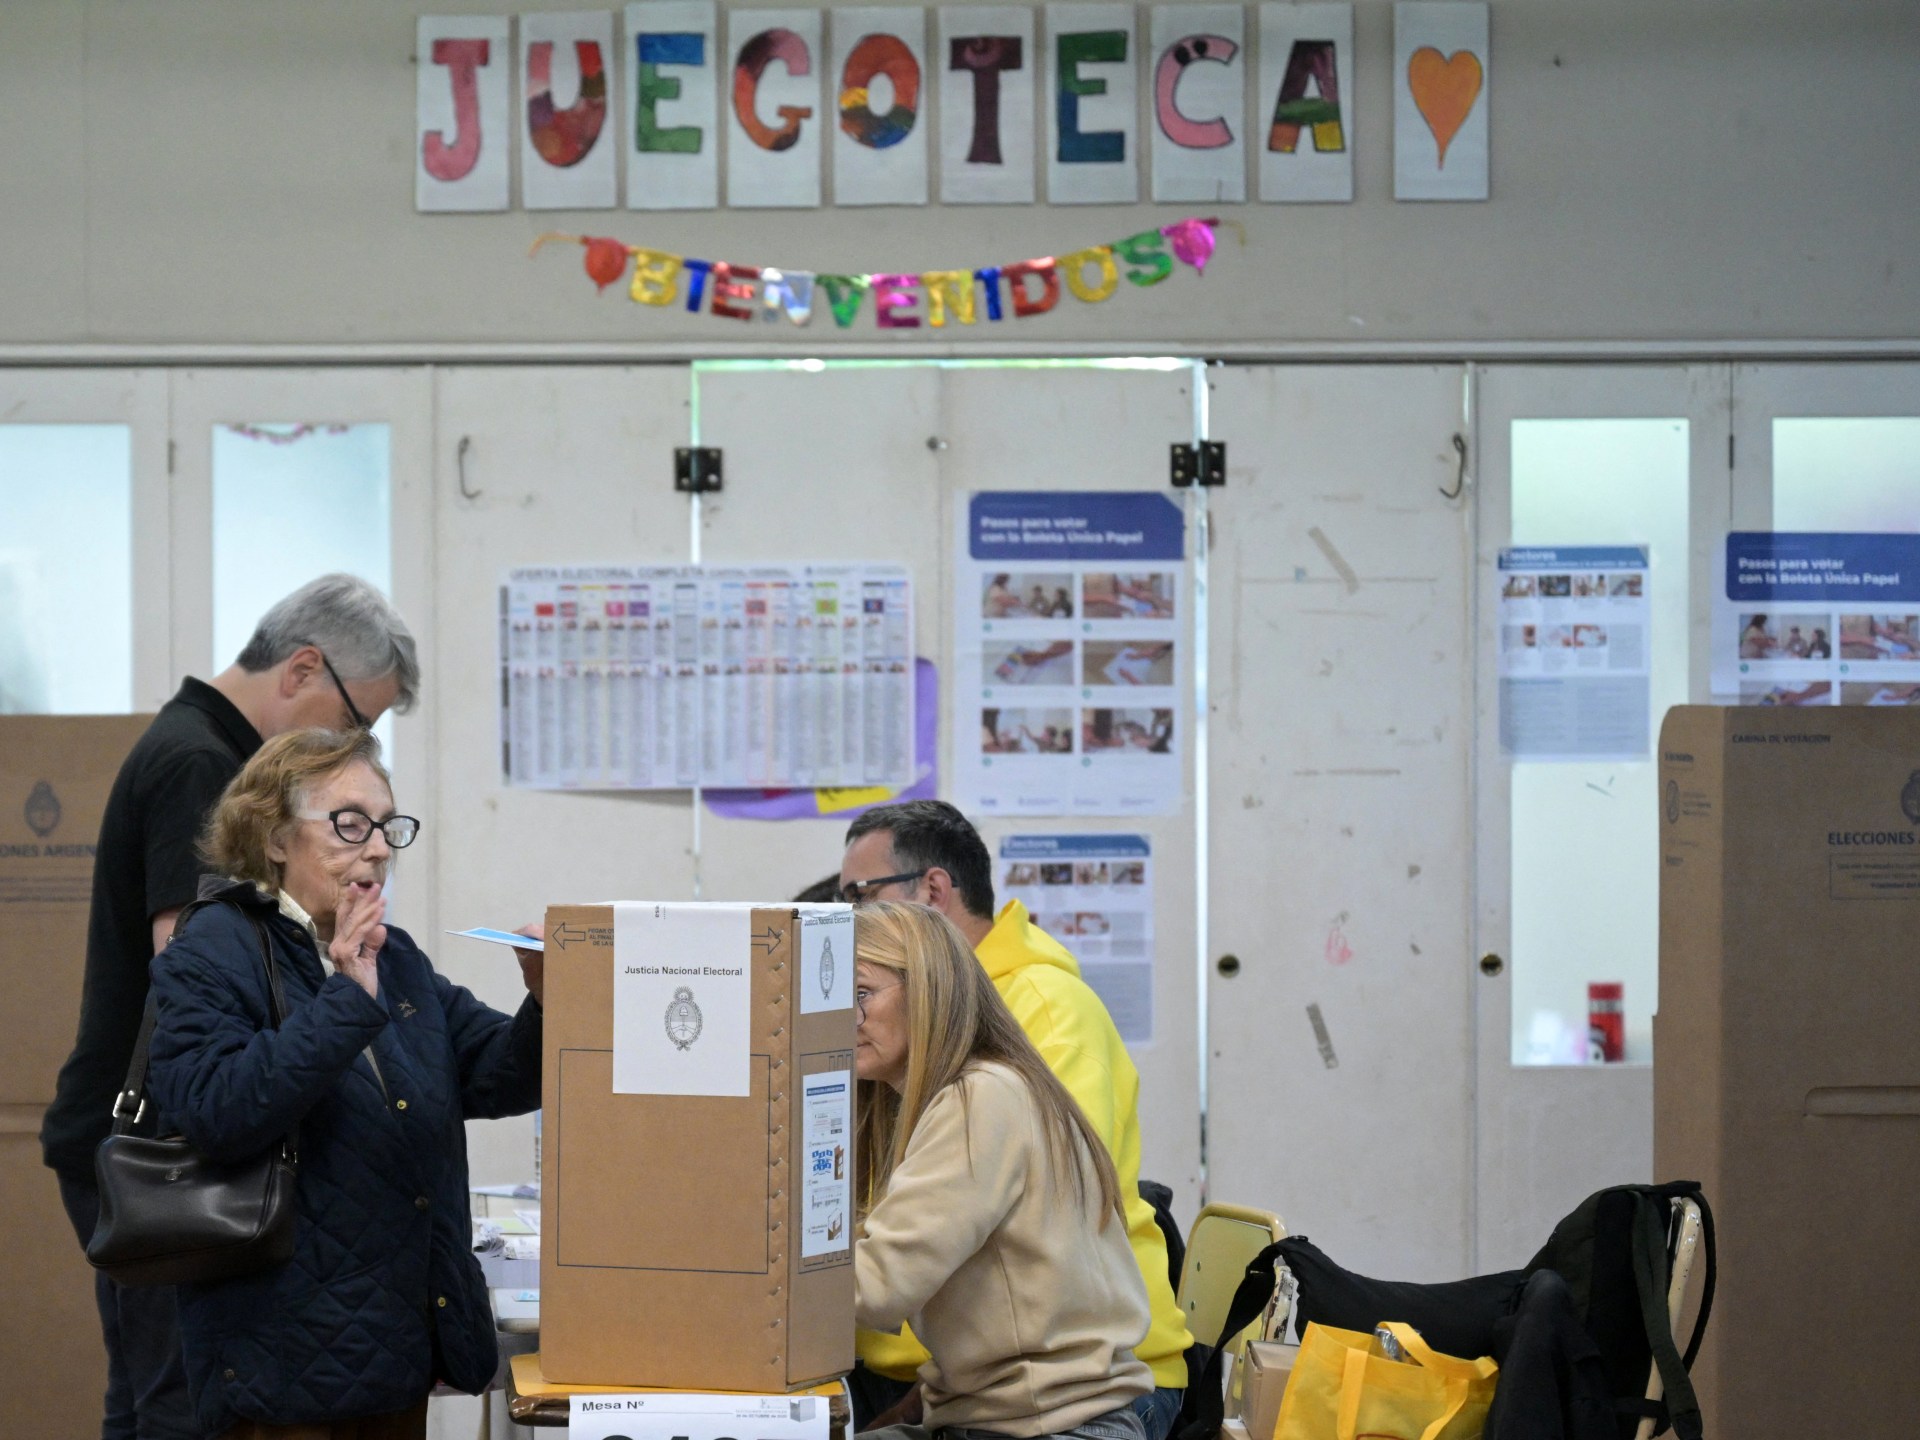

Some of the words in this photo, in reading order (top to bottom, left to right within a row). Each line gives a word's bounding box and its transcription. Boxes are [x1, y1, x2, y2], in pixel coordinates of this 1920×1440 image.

[423, 28, 1346, 182] JUEGOTECA
[630, 229, 1172, 329] BIENVENIDOS
[980, 516, 1019, 528] Pasos
[1021, 518, 1051, 530] para
[981, 533, 1006, 543] con
[1007, 532, 1021, 543] la
[1022, 531, 1065, 543] Boleta
[1105, 531, 1144, 545] Papel
[1738, 558, 1777, 569] Pasos
[1779, 559, 1809, 571] para
[1810, 559, 1845, 569] votar
[1738, 574, 1763, 584] con
[1765, 572, 1777, 584] la
[1780, 572, 1822, 585] Boleta
[1863, 572, 1899, 586] Papel
[1828, 831, 1916, 846] ELECCIONES
[0, 844, 39, 857] ONES
[44, 844, 97, 857] ARGEN
[625, 965, 660, 975] Justicia
[662, 966, 701, 975] Nacional
[703, 967, 743, 976] Electoral
[582, 1401, 621, 1412] Mesa
